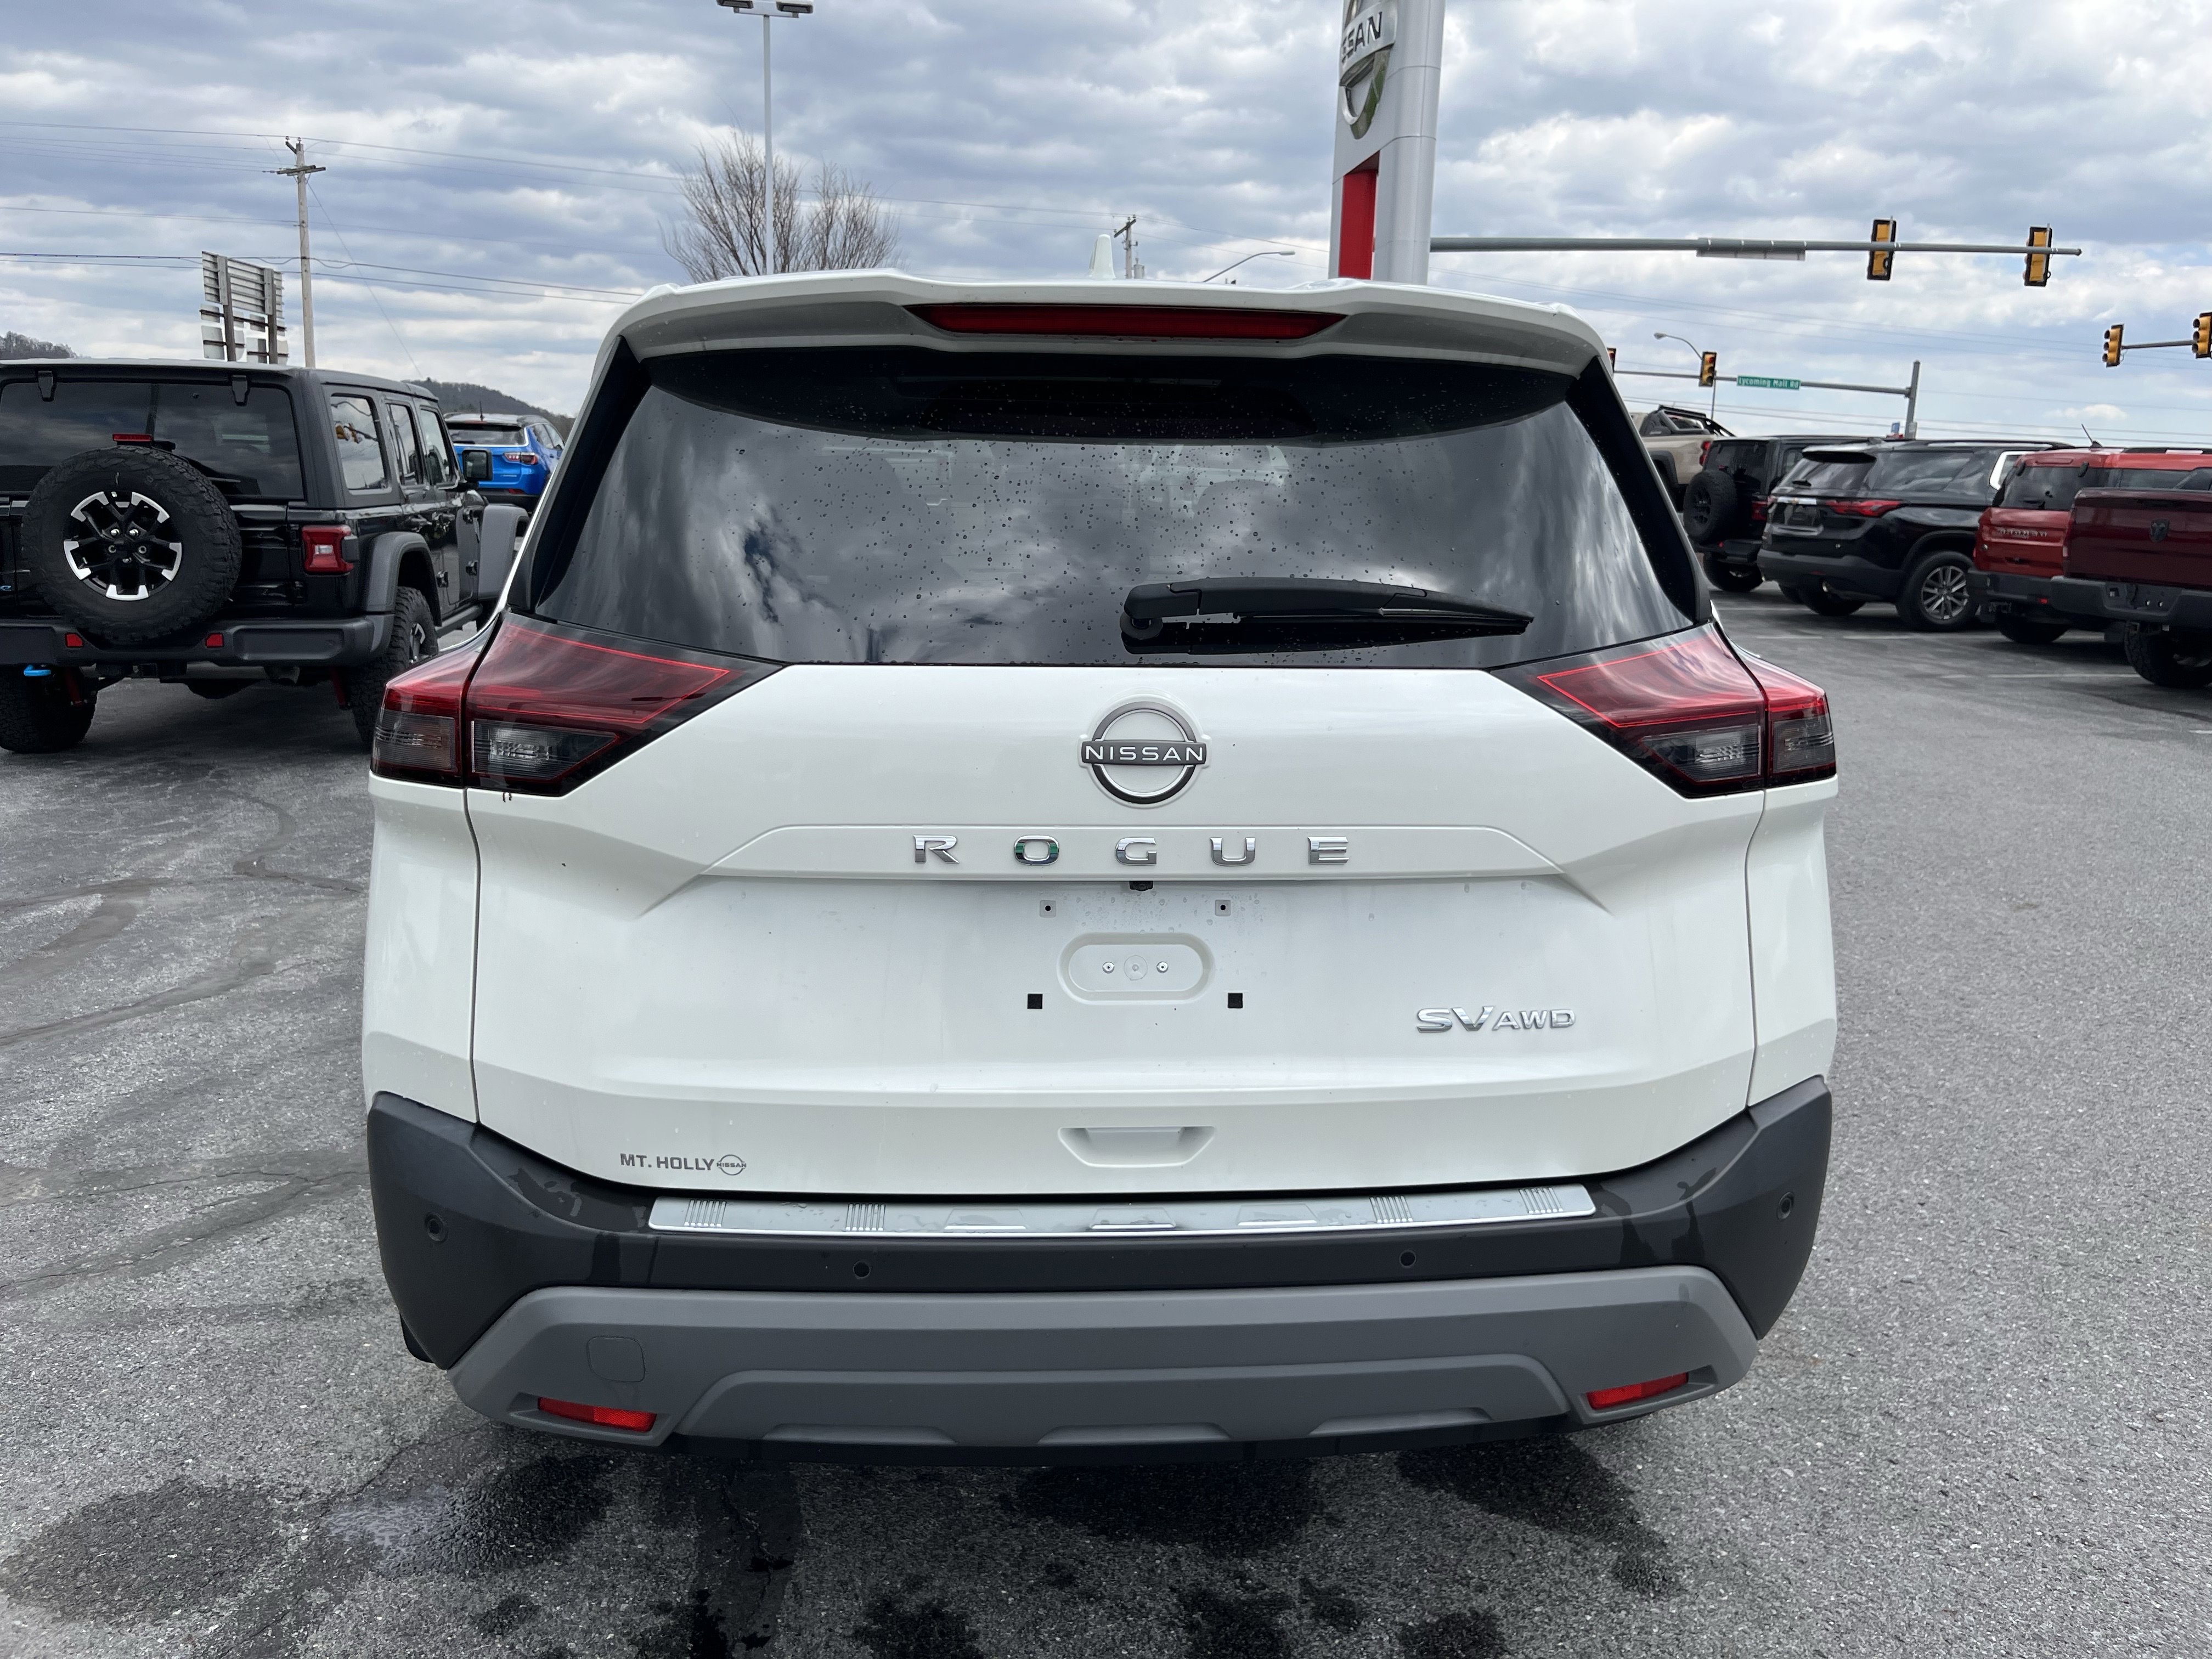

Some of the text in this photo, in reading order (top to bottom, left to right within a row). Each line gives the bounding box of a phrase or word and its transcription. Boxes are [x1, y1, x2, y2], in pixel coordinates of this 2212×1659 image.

[1739, 377, 1799, 388] Lycoming Mall Rd
[1085, 746, 1203, 761] NISSAN
[913, 834, 1350, 867] ROGUE
[1416, 1005, 1576, 1034] SV AWD
[620, 1153, 652, 1168] MT.
[656, 1156, 715, 1171] HOLLY
